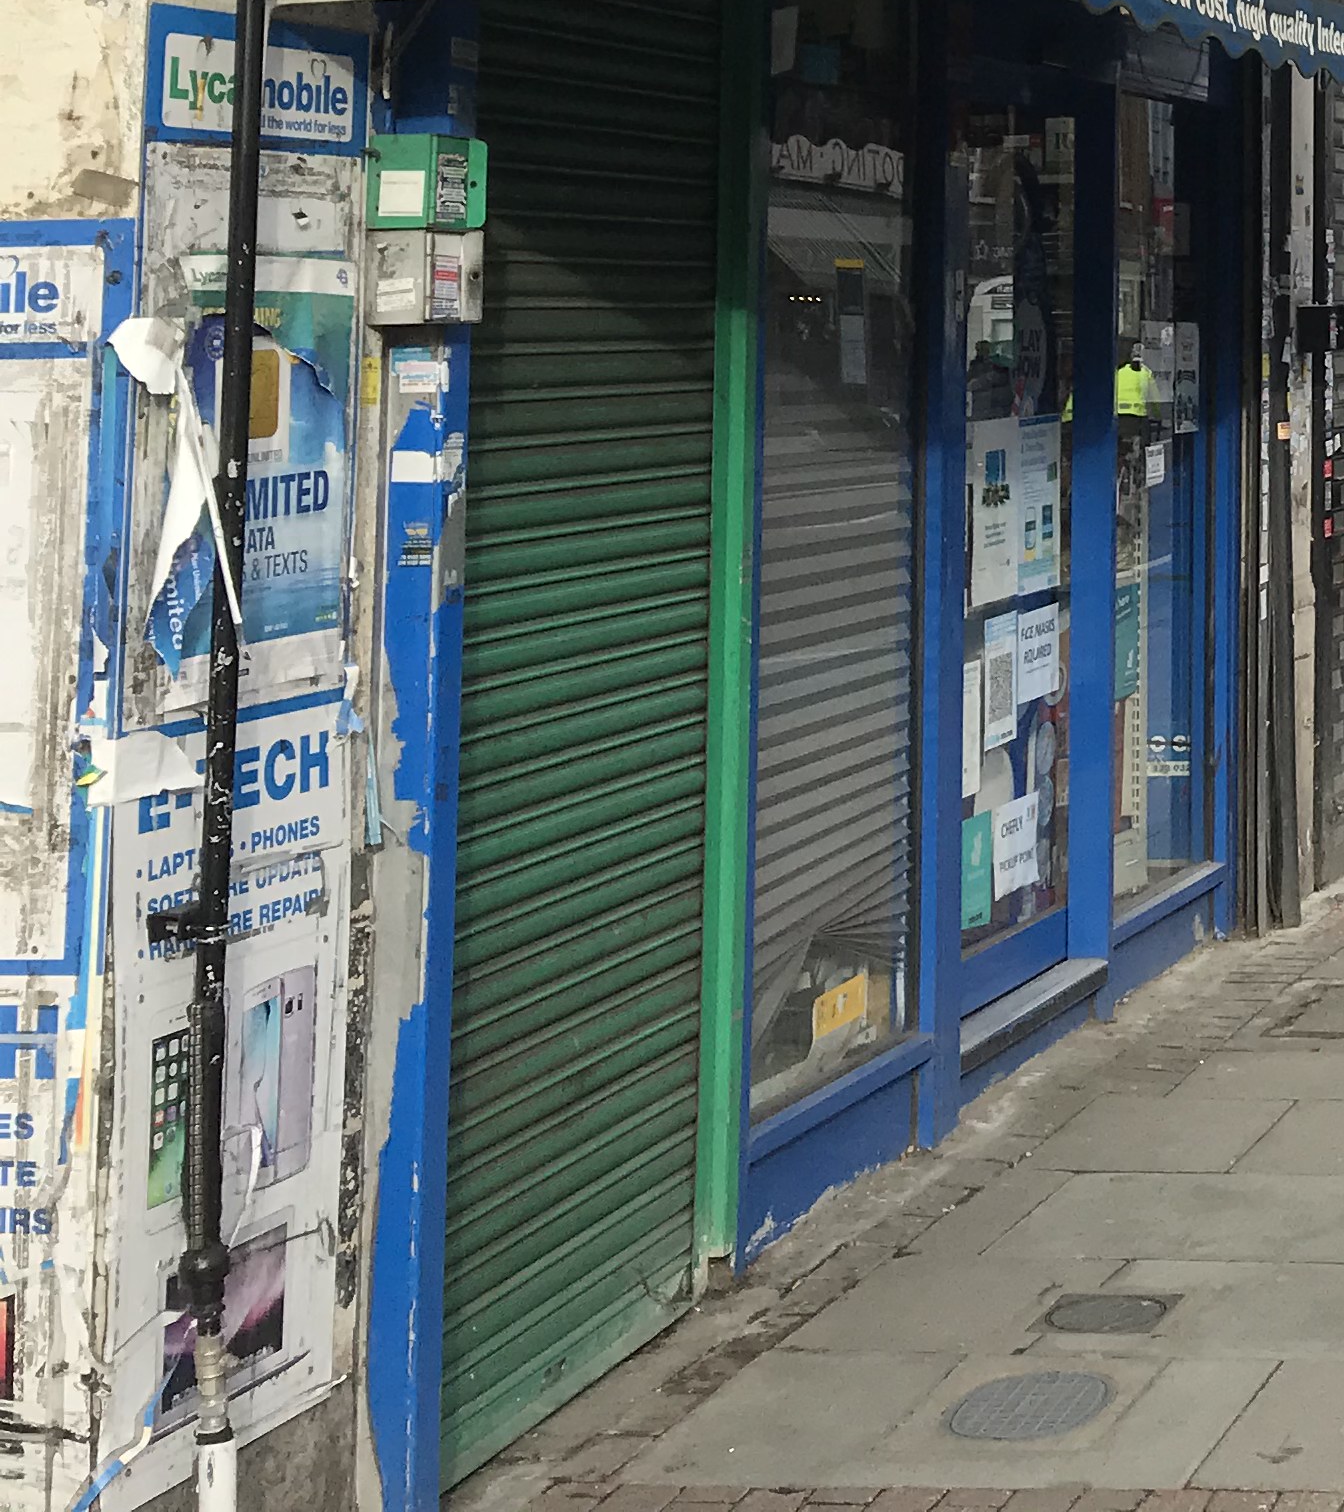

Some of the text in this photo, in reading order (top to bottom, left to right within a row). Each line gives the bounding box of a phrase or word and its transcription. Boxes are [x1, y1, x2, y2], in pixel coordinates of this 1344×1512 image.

[1270, 9, 1315, 56] quality
[169, 56, 348, 117] Lycaobile
[268, 116, 347, 136] the world for less
[246, 526, 276, 554] ATA
[251, 549, 308, 581] & TEXTS
[251, 816, 320, 853] PHONES
